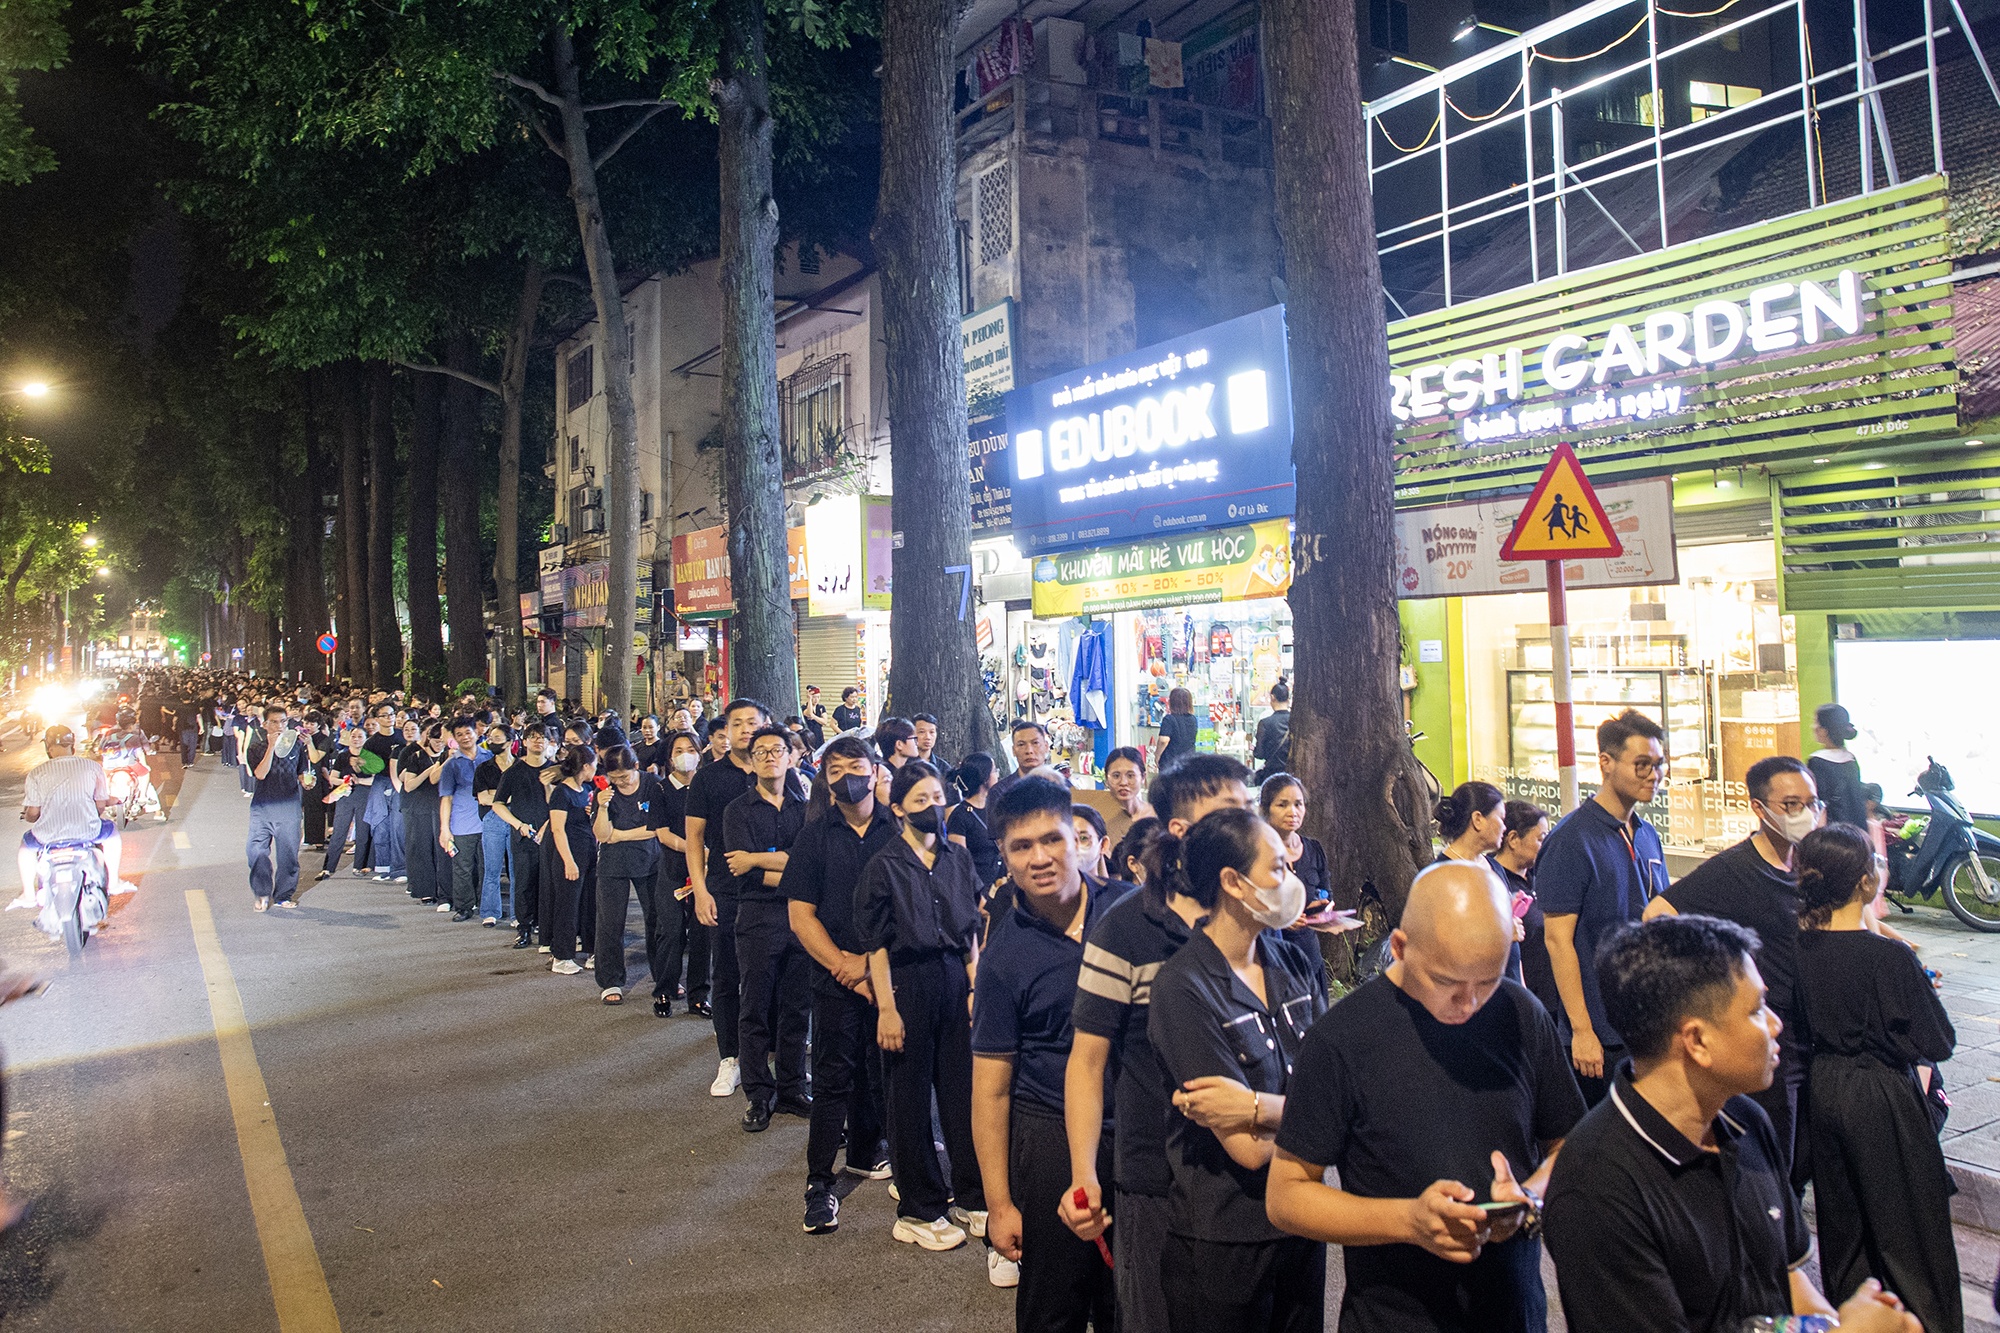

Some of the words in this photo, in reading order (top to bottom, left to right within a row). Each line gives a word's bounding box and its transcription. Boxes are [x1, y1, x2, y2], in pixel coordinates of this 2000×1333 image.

[972, 318, 1005, 345] PHONG
[1541, 270, 1865, 391] GARDEN
[1463, 413, 1516, 441] bánh
[1620, 384, 1681, 419] ngày
[1049, 382, 1218, 472] EDUBOOK
[1856, 425, 1869, 436] 47
[1871, 422, 1884, 434] Lò
[1886, 419, 1909, 432] Đúc
[1163, 514, 1207, 526] edubook.com.vn
[1238, 505, 1246, 516] 47
[1247, 505, 1255, 515] Lò
[1257, 503, 1269, 514] Đúc
[1422, 523, 1458, 544] NÓNG
[1060, 547, 1112, 582] KHUYẾN
[1118, 545, 1144, 574] MÃI
[1150, 542, 1171, 569] HÈ
[1177, 543, 1205, 564] VUI
[1211, 535, 1246, 566] HỌC
[1446, 560, 1473, 580] 20K
[1084, 586, 1099, 599] 5%
[1115, 583, 1137, 596] 10%
[1154, 577, 1178, 591] 20%
[1197, 572, 1224, 586] 50%
[1704, 779, 1749, 797] FRES
